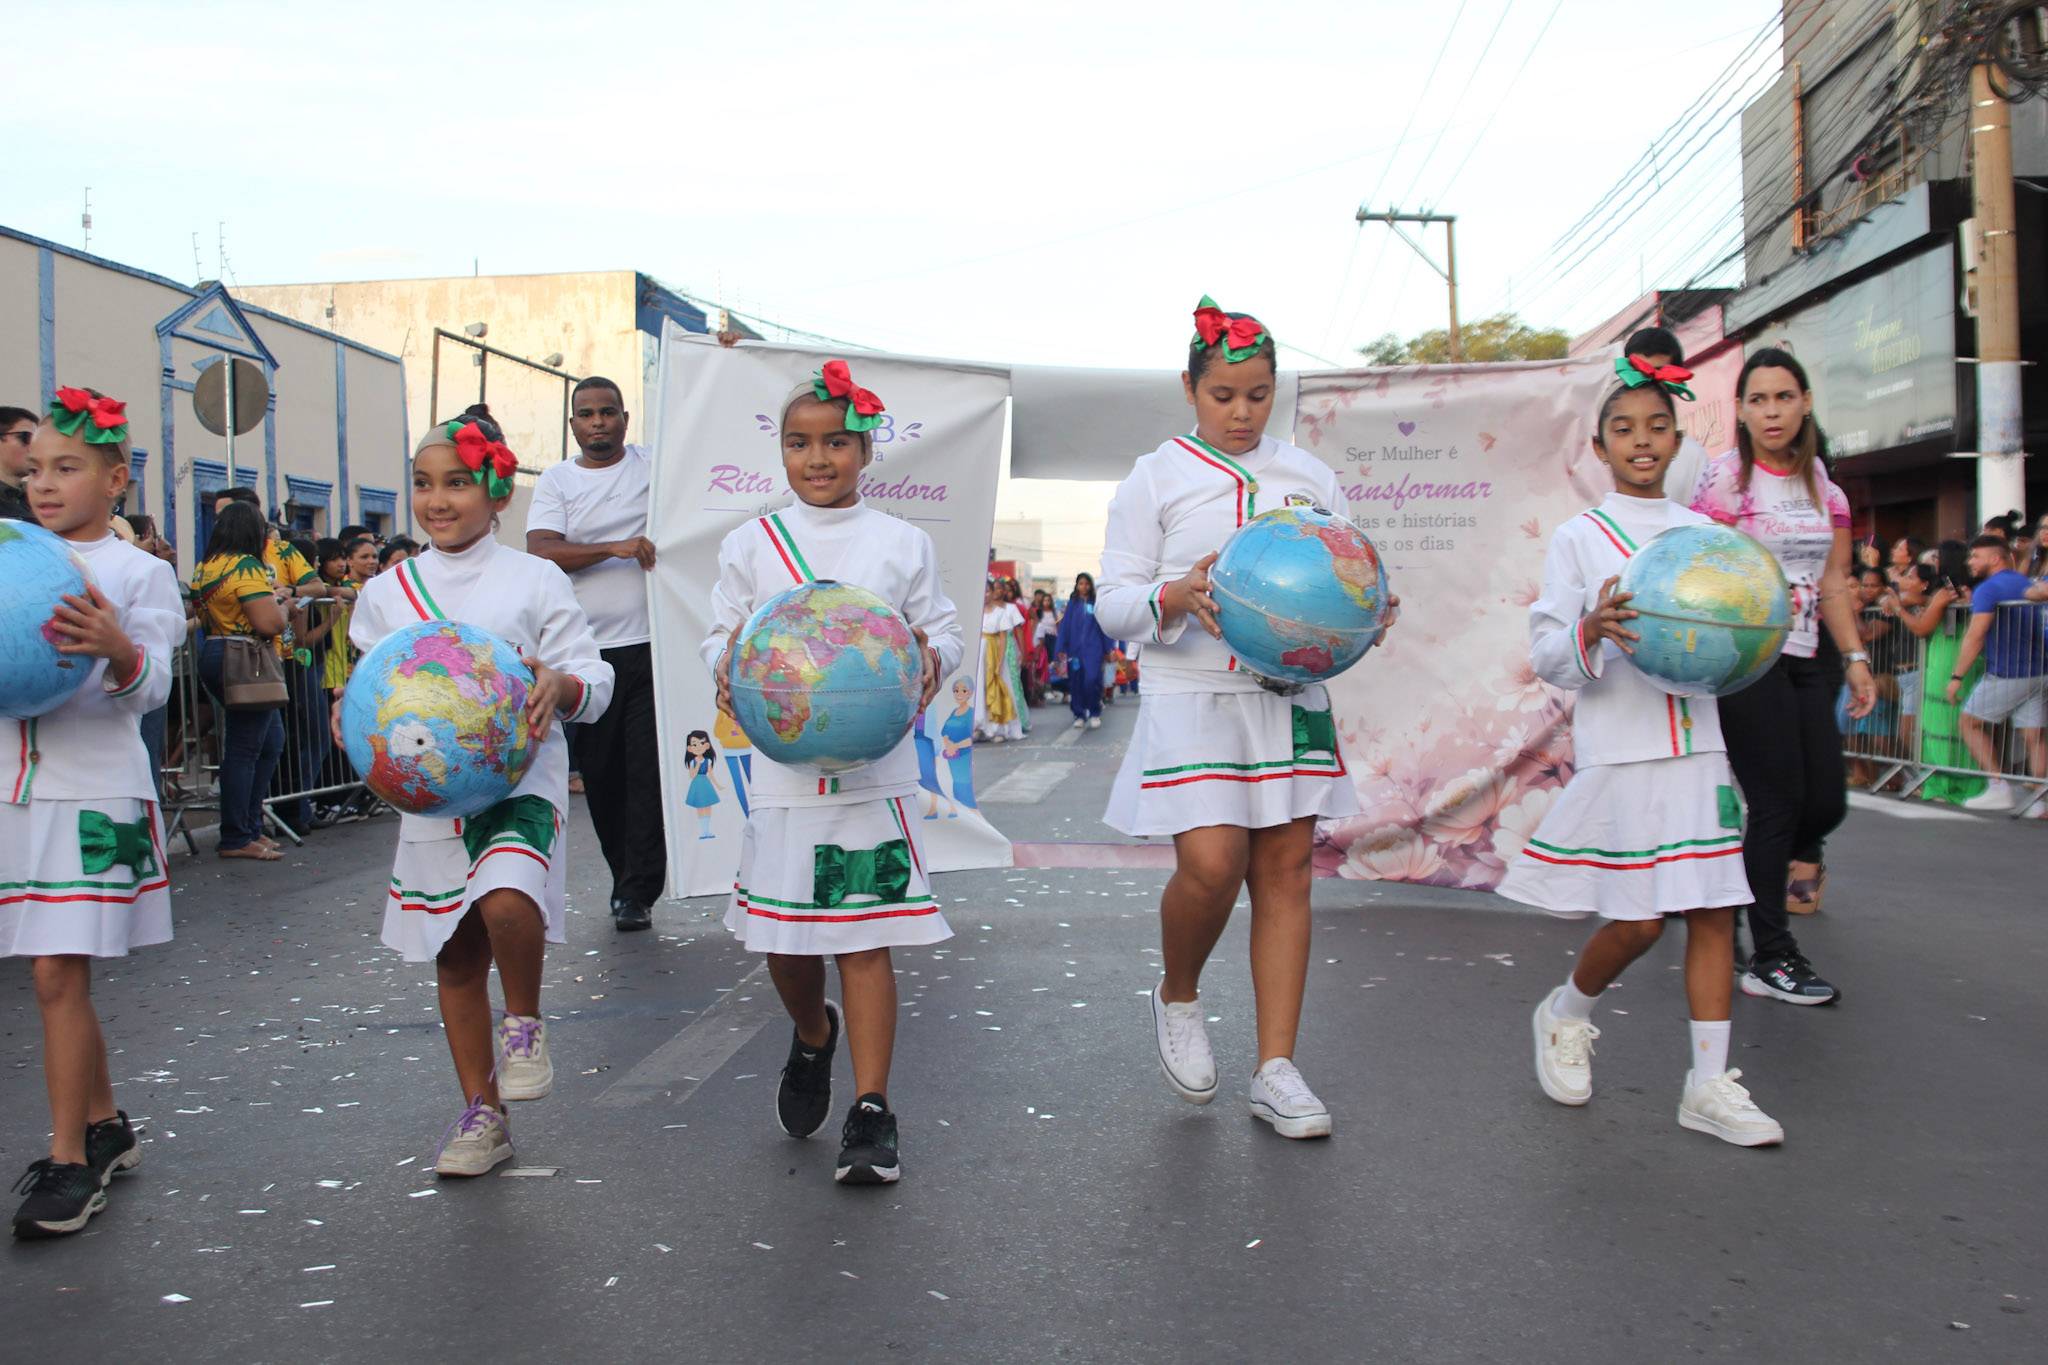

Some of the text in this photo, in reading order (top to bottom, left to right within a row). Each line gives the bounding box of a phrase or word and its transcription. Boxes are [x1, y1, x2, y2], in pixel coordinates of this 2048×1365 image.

[1346, 446, 1458, 462] Ser Mulher é
[708, 464, 773, 494] Rita
[1336, 471, 1492, 510] ransformar
[1387, 517, 1397, 529] e
[1403, 513, 1477, 529] histórias
[1394, 540, 1414, 551] os
[1420, 536, 1455, 551] dias
[1769, 969, 1797, 992] FILA
